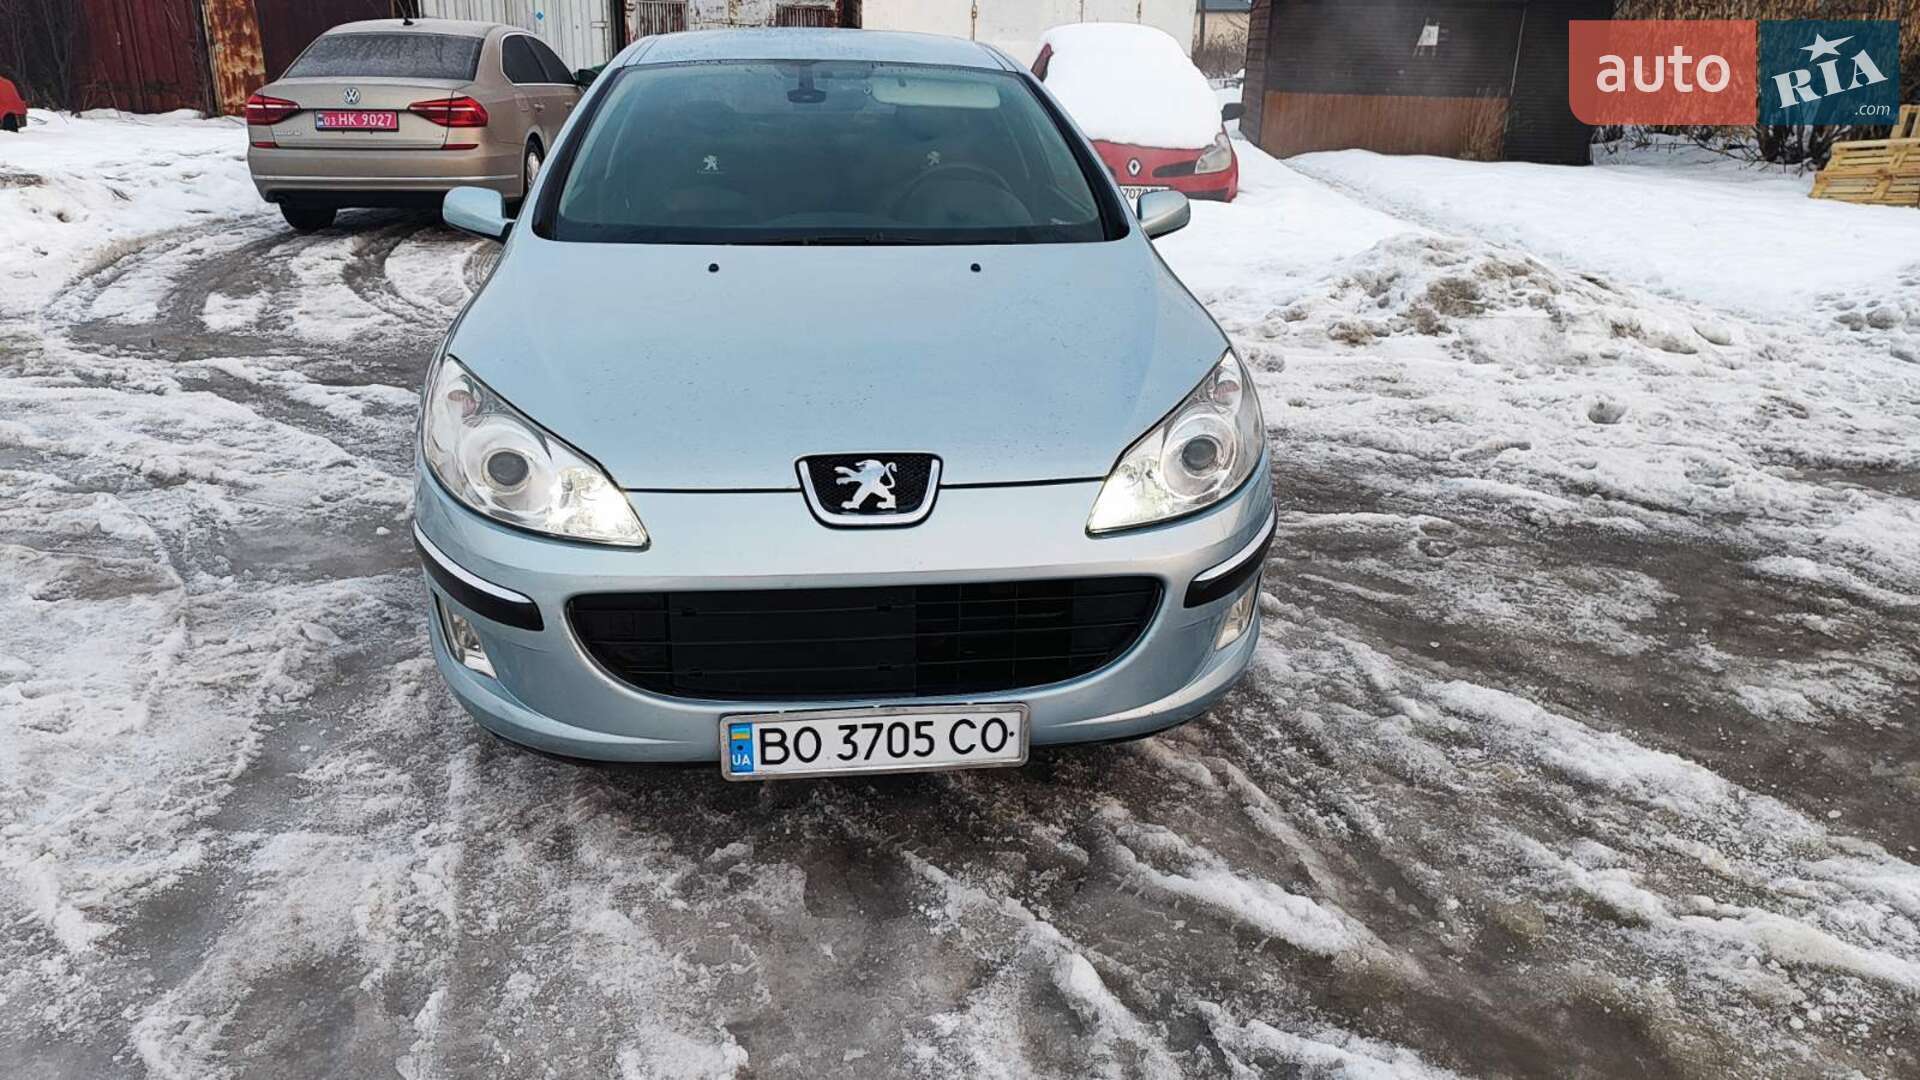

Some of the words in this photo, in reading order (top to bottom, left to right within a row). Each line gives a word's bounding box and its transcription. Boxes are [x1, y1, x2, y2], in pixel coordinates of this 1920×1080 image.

[339, 113, 357, 126] HK
[361, 113, 392, 126] 9027
[759, 726, 822, 766] BO
[836, 720, 936, 761] 3705
[949, 717, 1009, 755] CO
[732, 753, 751, 766] UA
